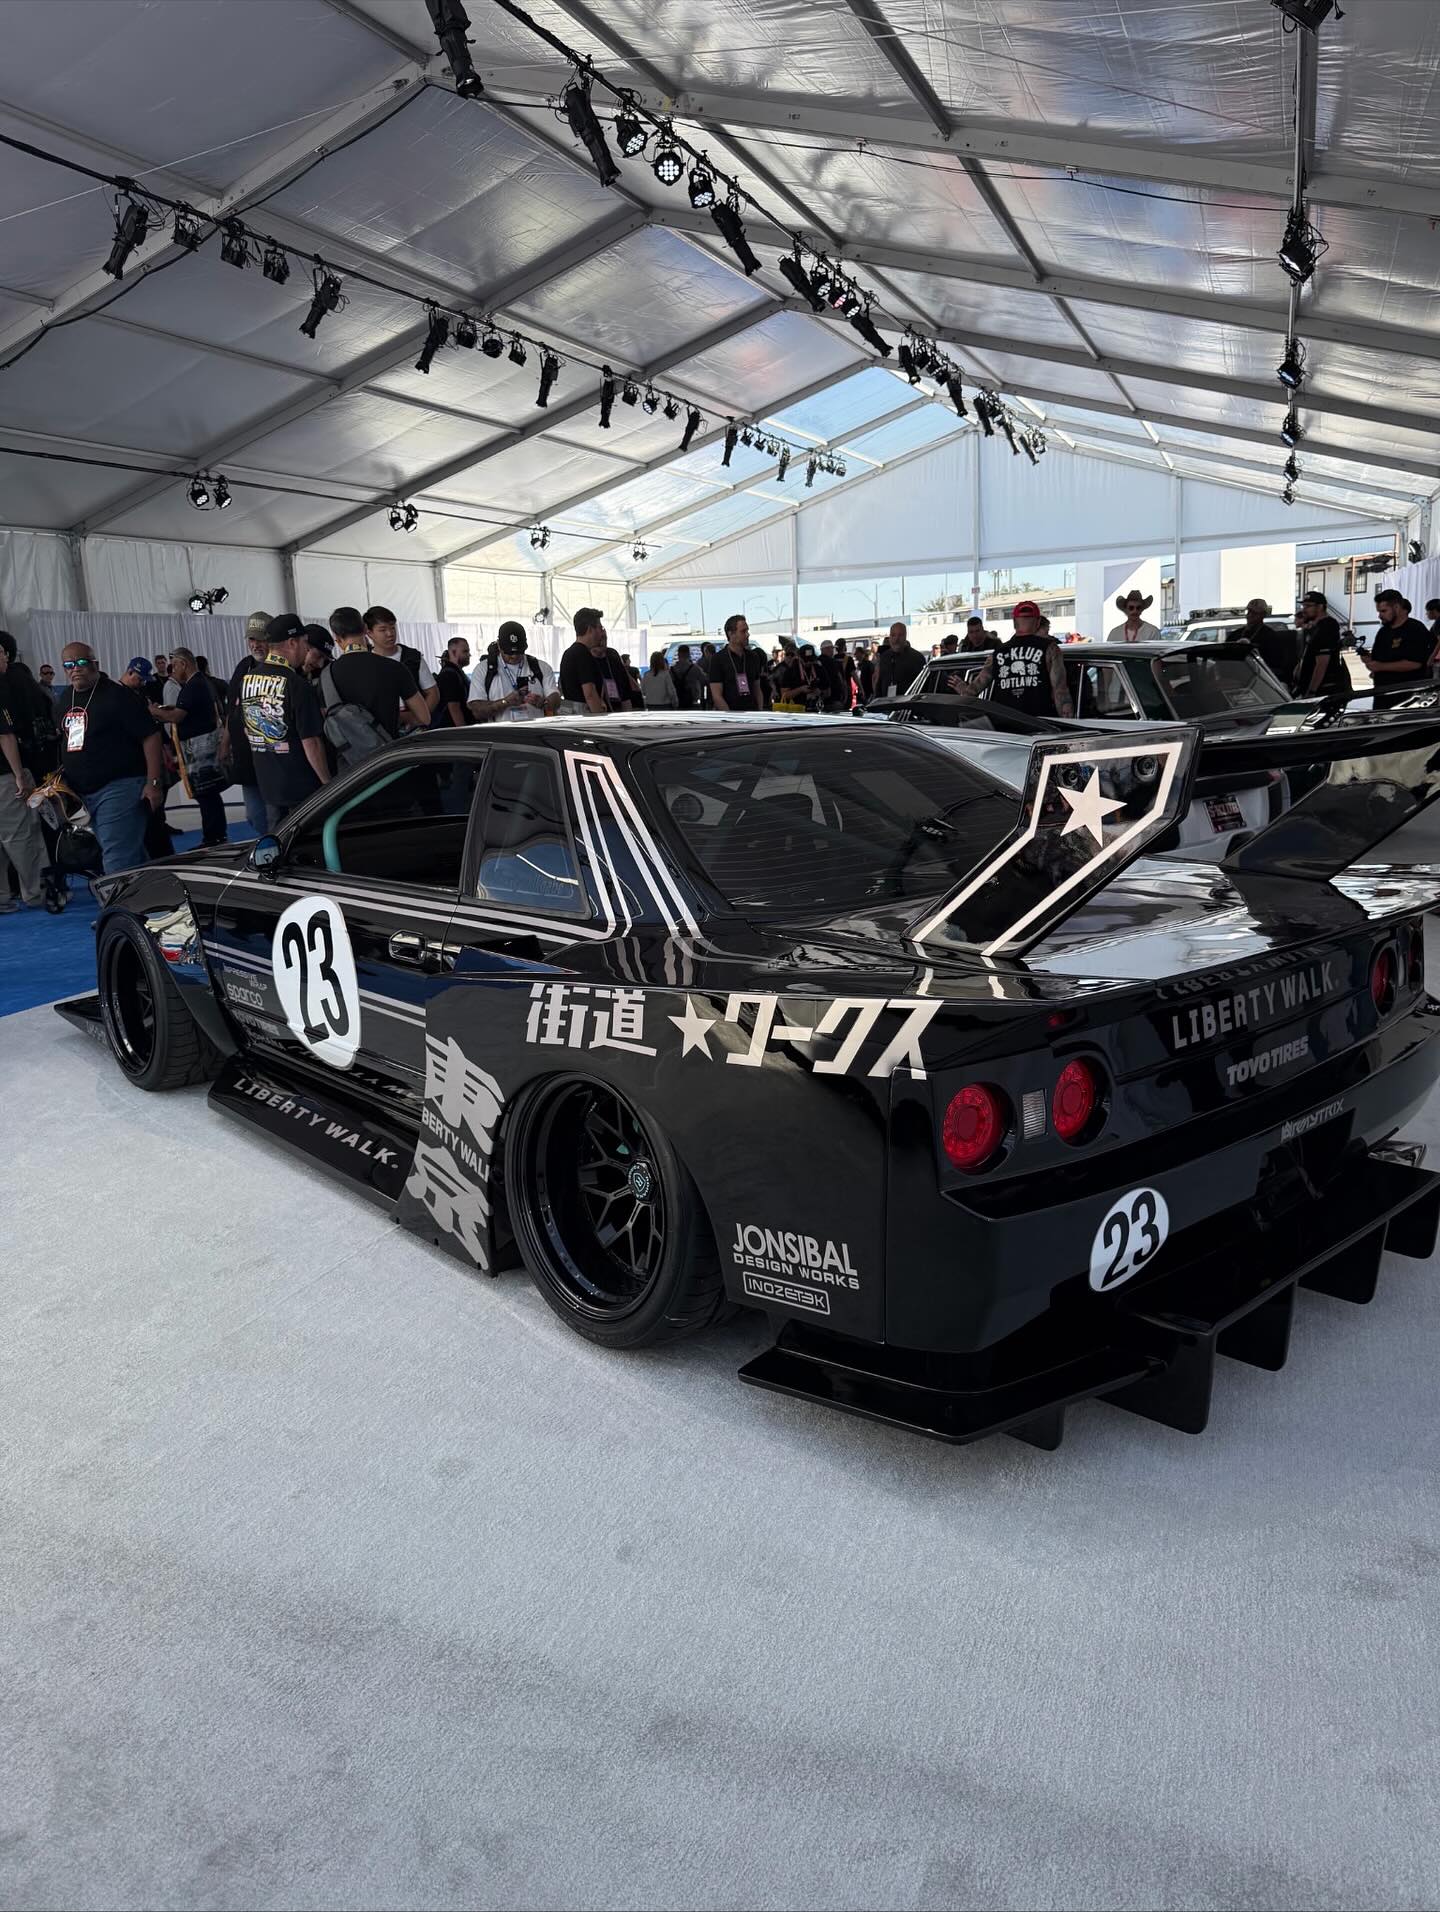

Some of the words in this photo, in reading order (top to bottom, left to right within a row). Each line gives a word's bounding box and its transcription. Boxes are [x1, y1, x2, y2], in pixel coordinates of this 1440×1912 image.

[1000, 677, 1038, 689] OUTLAWS
[282, 910, 349, 1045] 23
[526, 983, 657, 1057] 街道
[724, 993, 944, 1080] ワークス
[1172, 982, 1275, 1049] LIBERTY
[1227, 1053, 1271, 1086] TOYO
[1270, 1035, 1309, 1062] TIRES
[233, 1078, 327, 1127] LIBERTY
[732, 1223, 858, 1276] JONSIBAL
[1100, 1191, 1160, 1288] 23
[733, 1252, 793, 1275] DESIGN
[799, 1266, 860, 1290] WORKS
